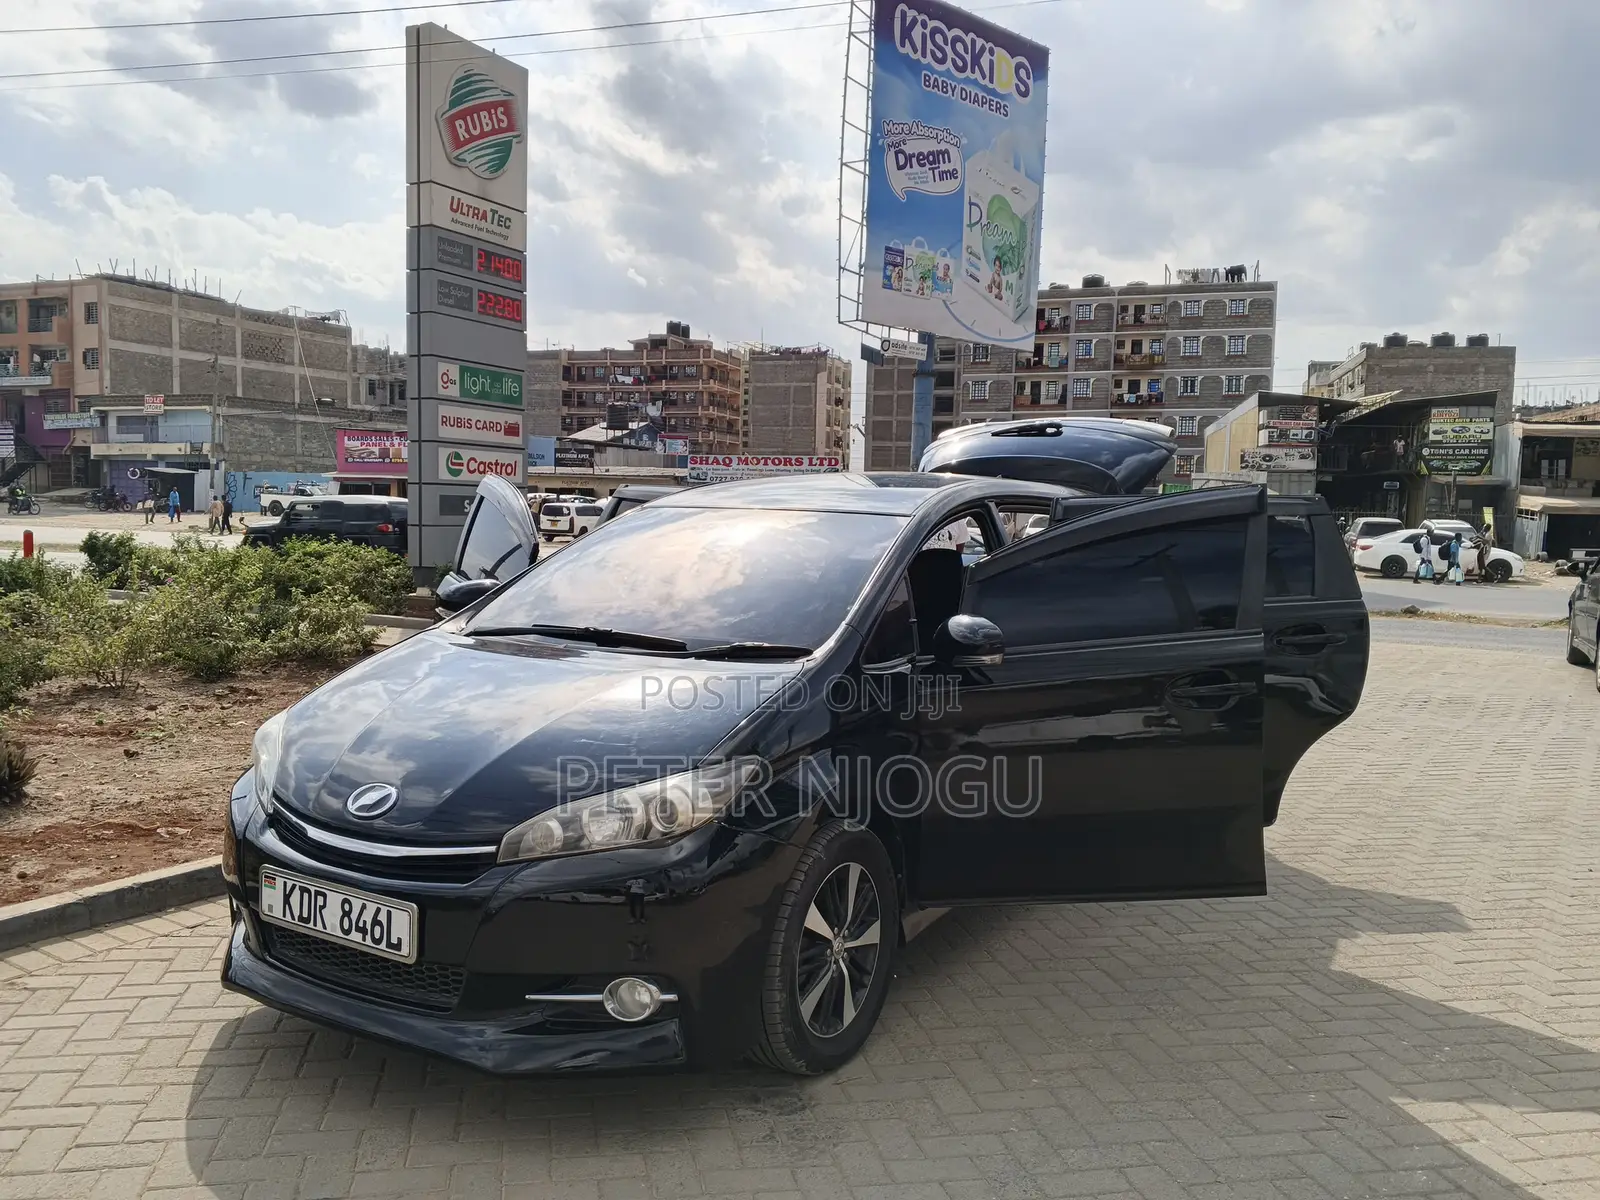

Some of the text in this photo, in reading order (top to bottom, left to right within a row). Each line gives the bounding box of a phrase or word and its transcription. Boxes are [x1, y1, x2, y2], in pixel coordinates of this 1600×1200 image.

[923, 73, 1009, 118] BABY DIAPERS
[883, 119, 961, 148] More Absorption
[887, 138, 907, 152] More
[894, 148, 951, 171] Dream
[928, 166, 959, 183] Time
[451, 217, 474, 230] Advanced
[475, 224, 485, 233] Fuel
[464, 372, 491, 394] light
[502, 377, 520, 397] life
[145, 396, 164, 404] TO LET
[474, 419, 502, 432] CARD
[466, 456, 518, 477] Castrol
[688, 455, 840, 468] SHAQ MOTORS LTD
[282, 880, 403, 953] KDR 846L
